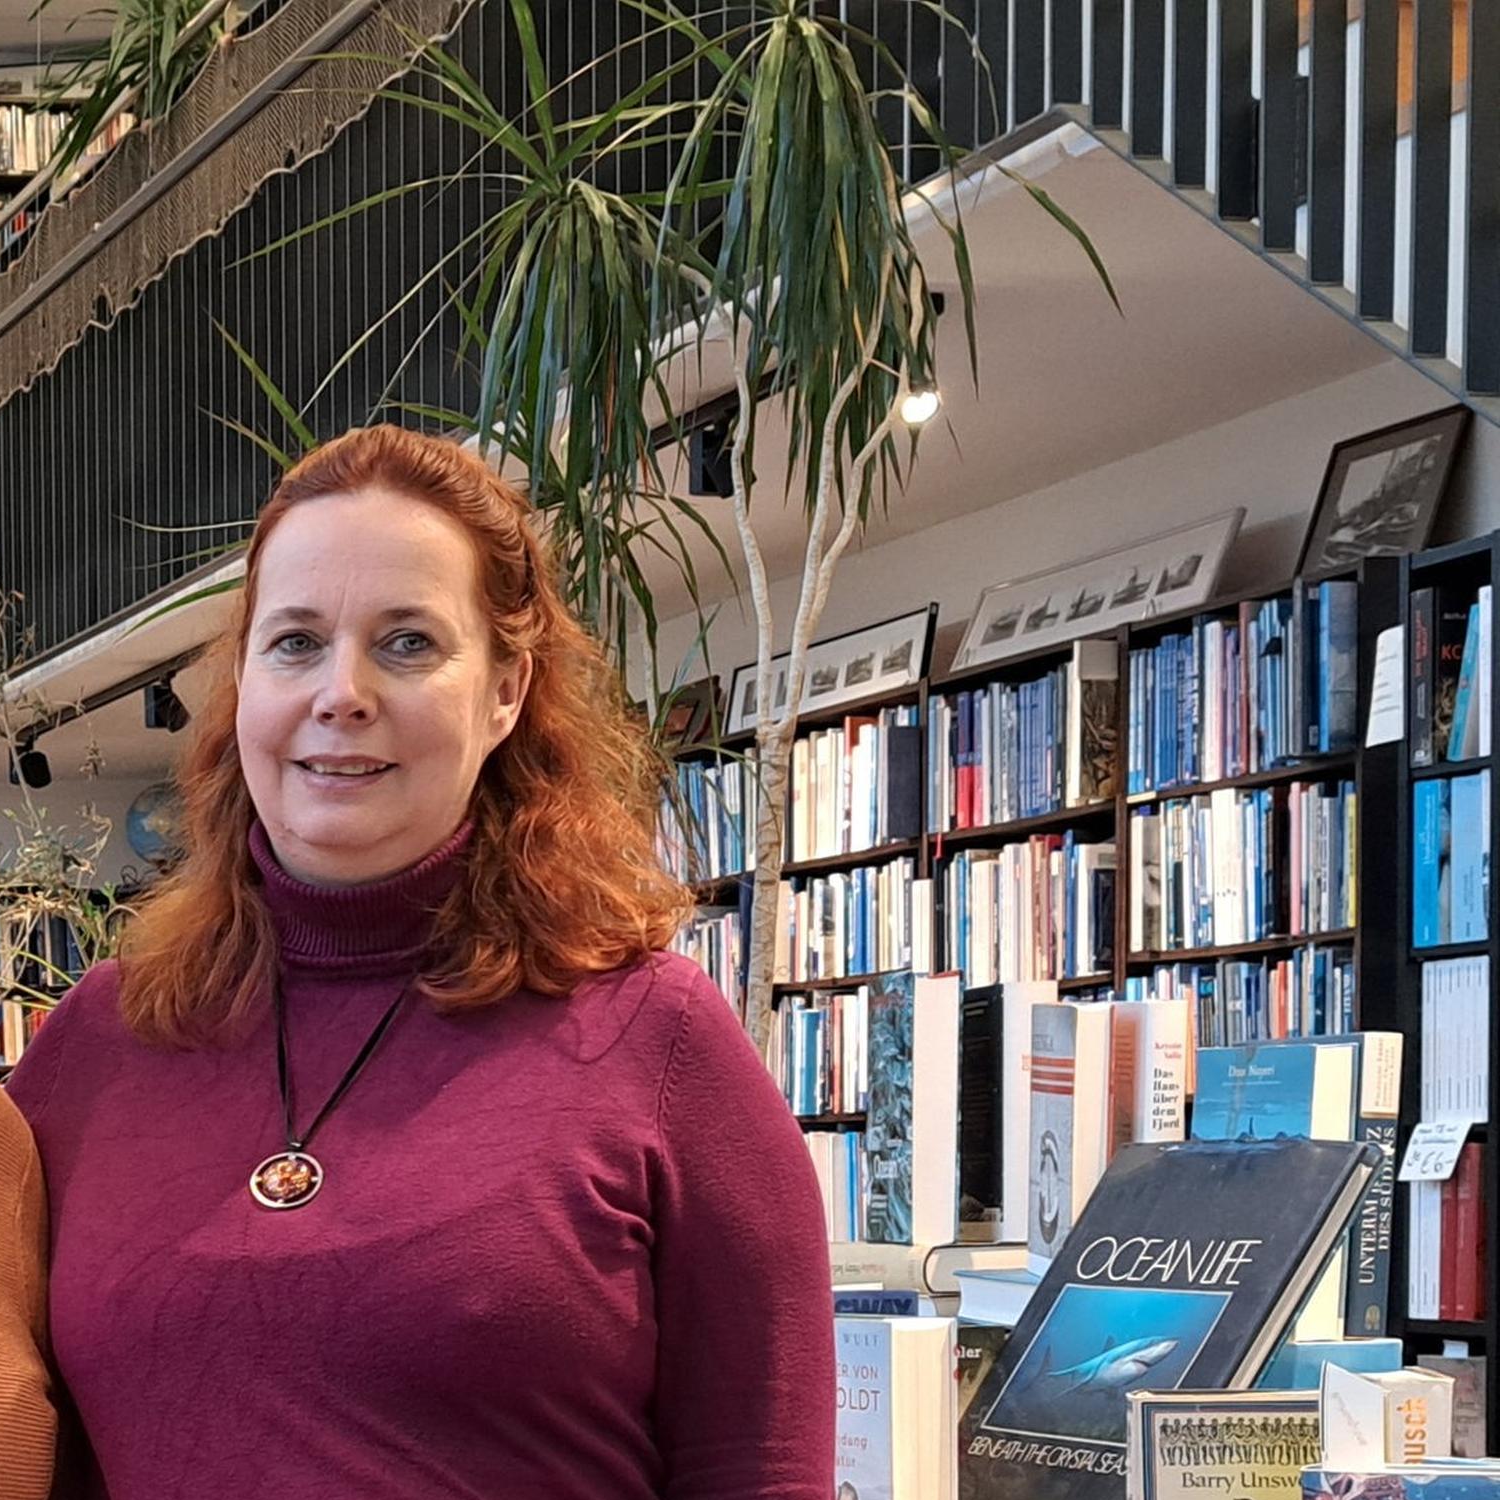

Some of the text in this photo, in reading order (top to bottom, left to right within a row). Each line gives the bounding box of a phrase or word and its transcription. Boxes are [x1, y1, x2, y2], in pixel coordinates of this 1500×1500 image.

[1358, 1198, 1379, 1284] UNTERM
[853, 1365, 878, 1379] VON
[967, 1435, 1026, 1463] BENEATH
[1044, 1446, 1097, 1473] CRYSTAL
[1181, 1471, 1235, 1493] Barry
